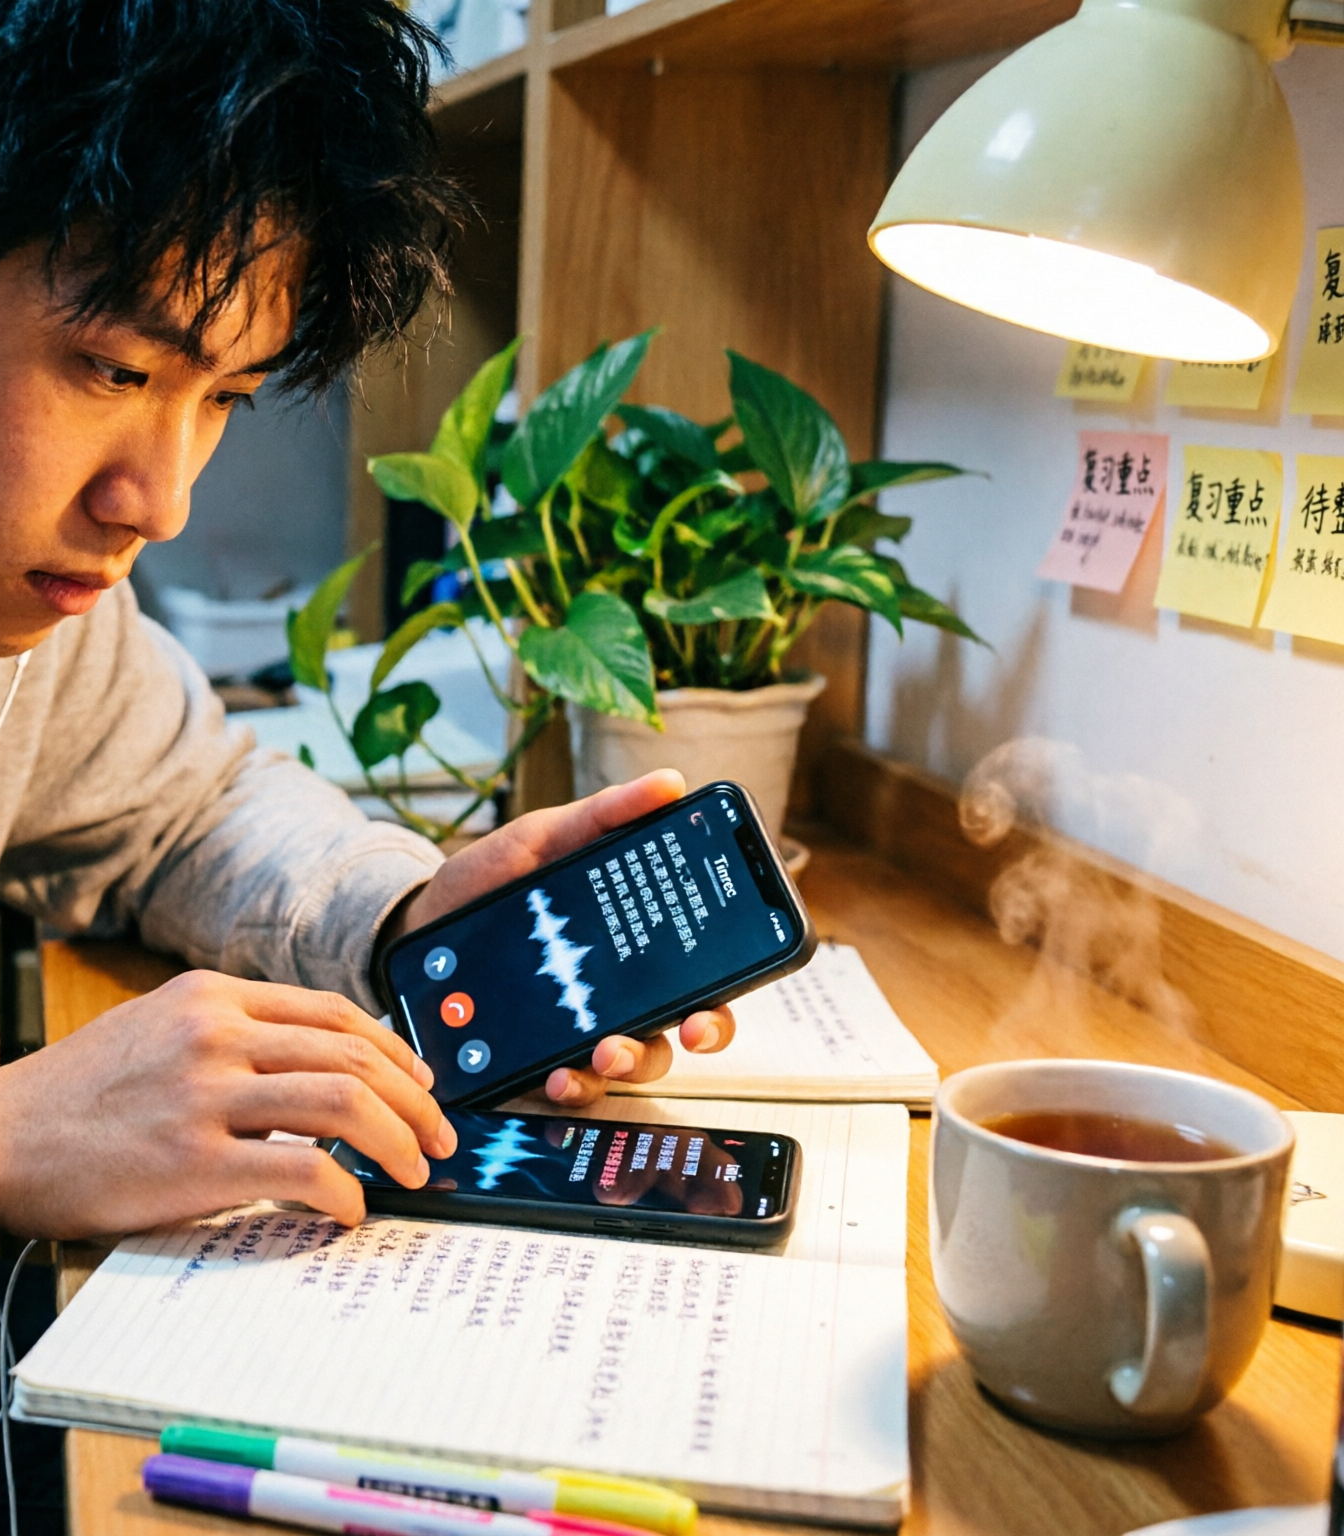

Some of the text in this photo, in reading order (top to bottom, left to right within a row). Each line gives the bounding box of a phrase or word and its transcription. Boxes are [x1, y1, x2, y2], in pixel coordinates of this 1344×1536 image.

[1083, 449, 1154, 496] 复习重点
[1186, 471, 1267, 527] 复习重点
